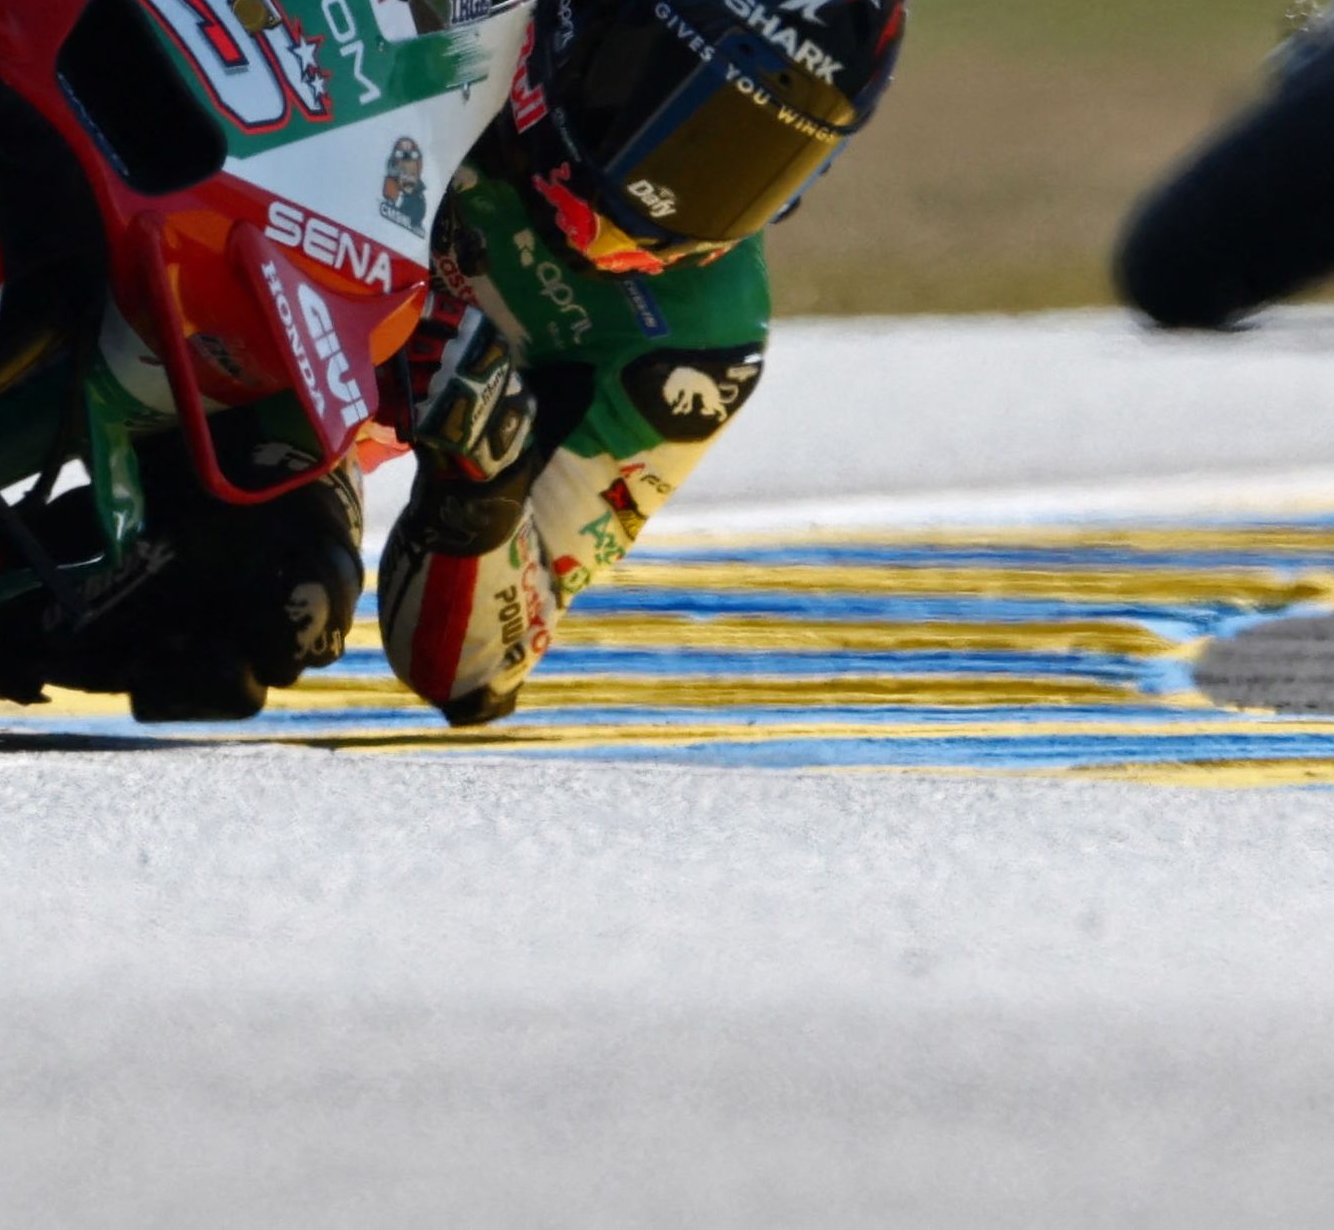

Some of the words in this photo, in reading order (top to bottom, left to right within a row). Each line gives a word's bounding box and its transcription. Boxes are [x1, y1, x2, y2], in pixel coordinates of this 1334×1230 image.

[655, 1, 716, 63] GIVES
[725, 63, 769, 106] YOU
[264, 202, 392, 294] SENA
[261, 260, 326, 420] HONDA
[297, 284, 369, 428] GIVI
